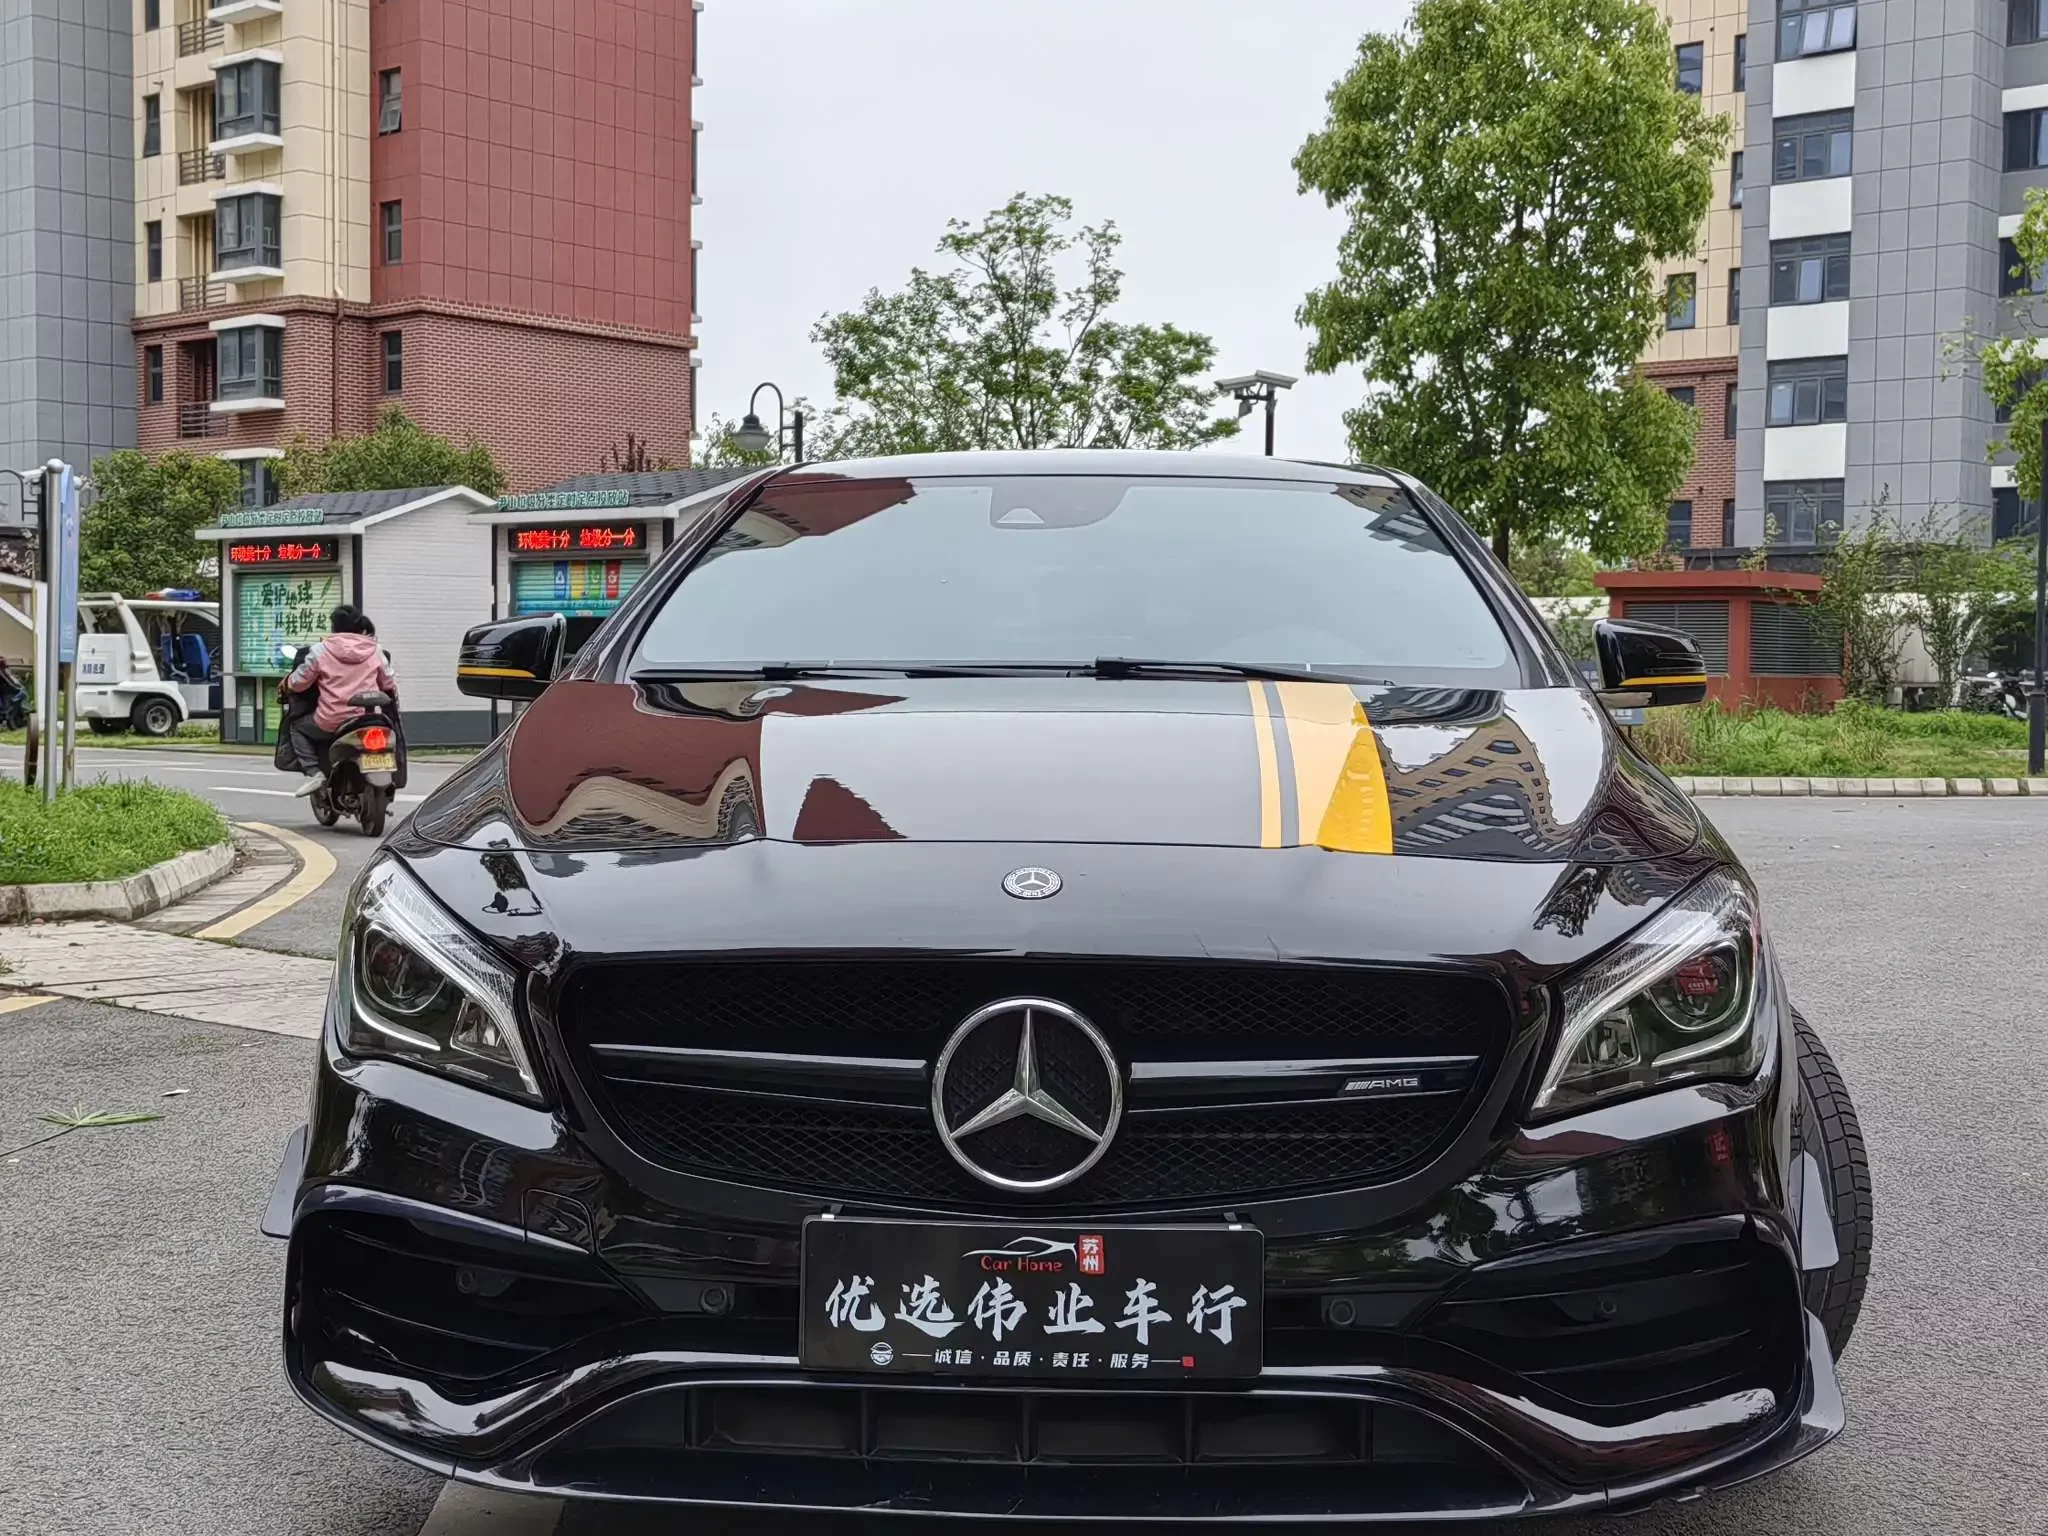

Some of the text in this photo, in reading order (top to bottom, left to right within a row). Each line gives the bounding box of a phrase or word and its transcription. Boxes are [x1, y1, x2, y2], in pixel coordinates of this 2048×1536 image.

[261, 580, 313, 610] 爱护地球
[275, 608, 327, 637] 从我做起
[1366, 1078, 1419, 1090] AMG
[980, 1255, 1063, 1272] Car Home
[1081, 1238, 1100, 1271] 苏州
[824, 1274, 1248, 1346] 优选伟业车行
